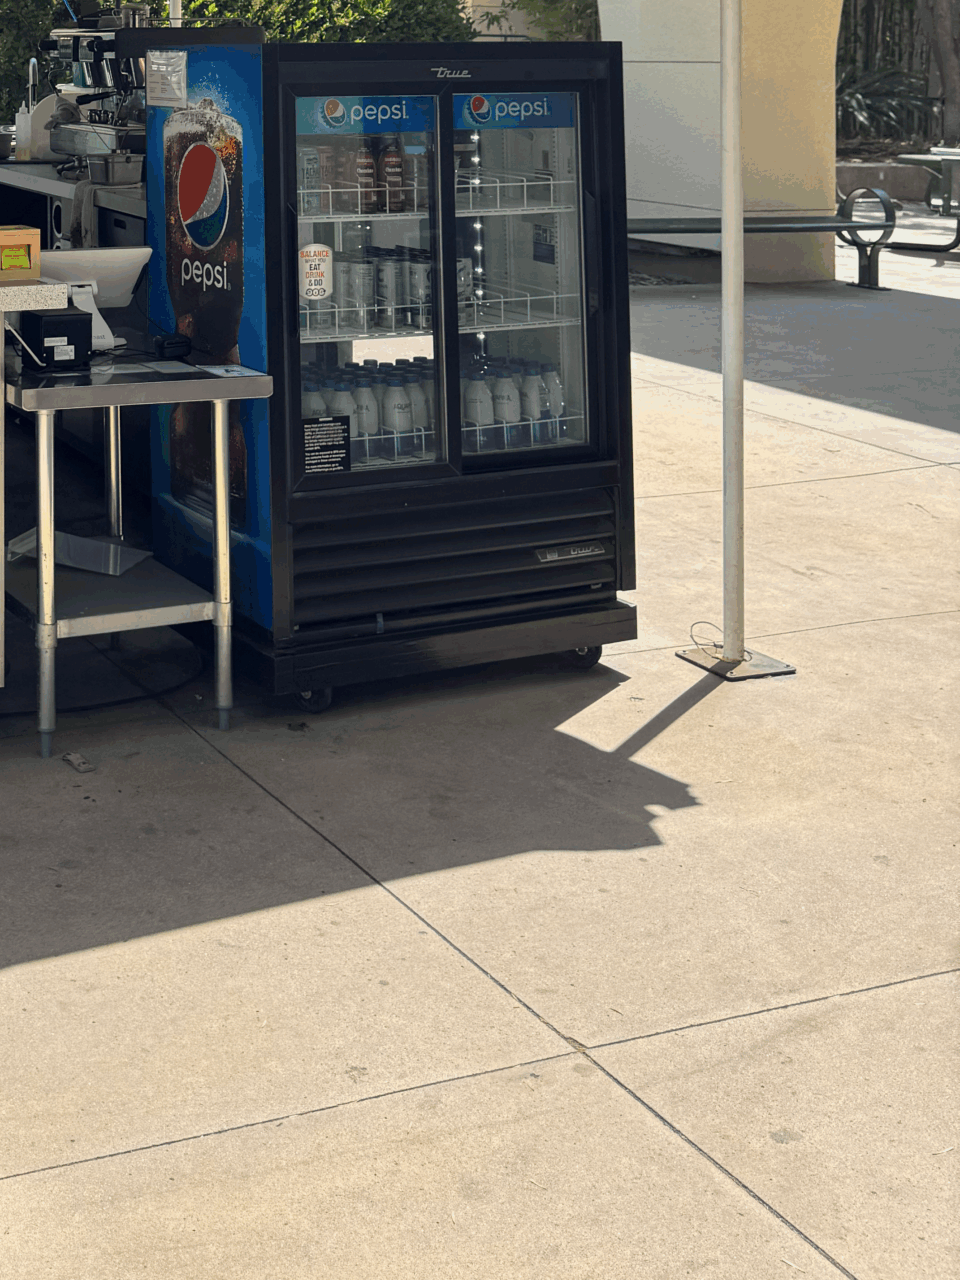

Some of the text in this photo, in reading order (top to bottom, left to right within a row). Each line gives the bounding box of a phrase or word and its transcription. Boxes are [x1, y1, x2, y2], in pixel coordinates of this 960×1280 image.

[351, 100, 407, 124] pepsi
[495, 97, 548, 121] pepsi
[300, 250, 330, 258] BALANCE
[181, 258, 227, 291] pepsi
[309, 263, 321, 271] EAT
